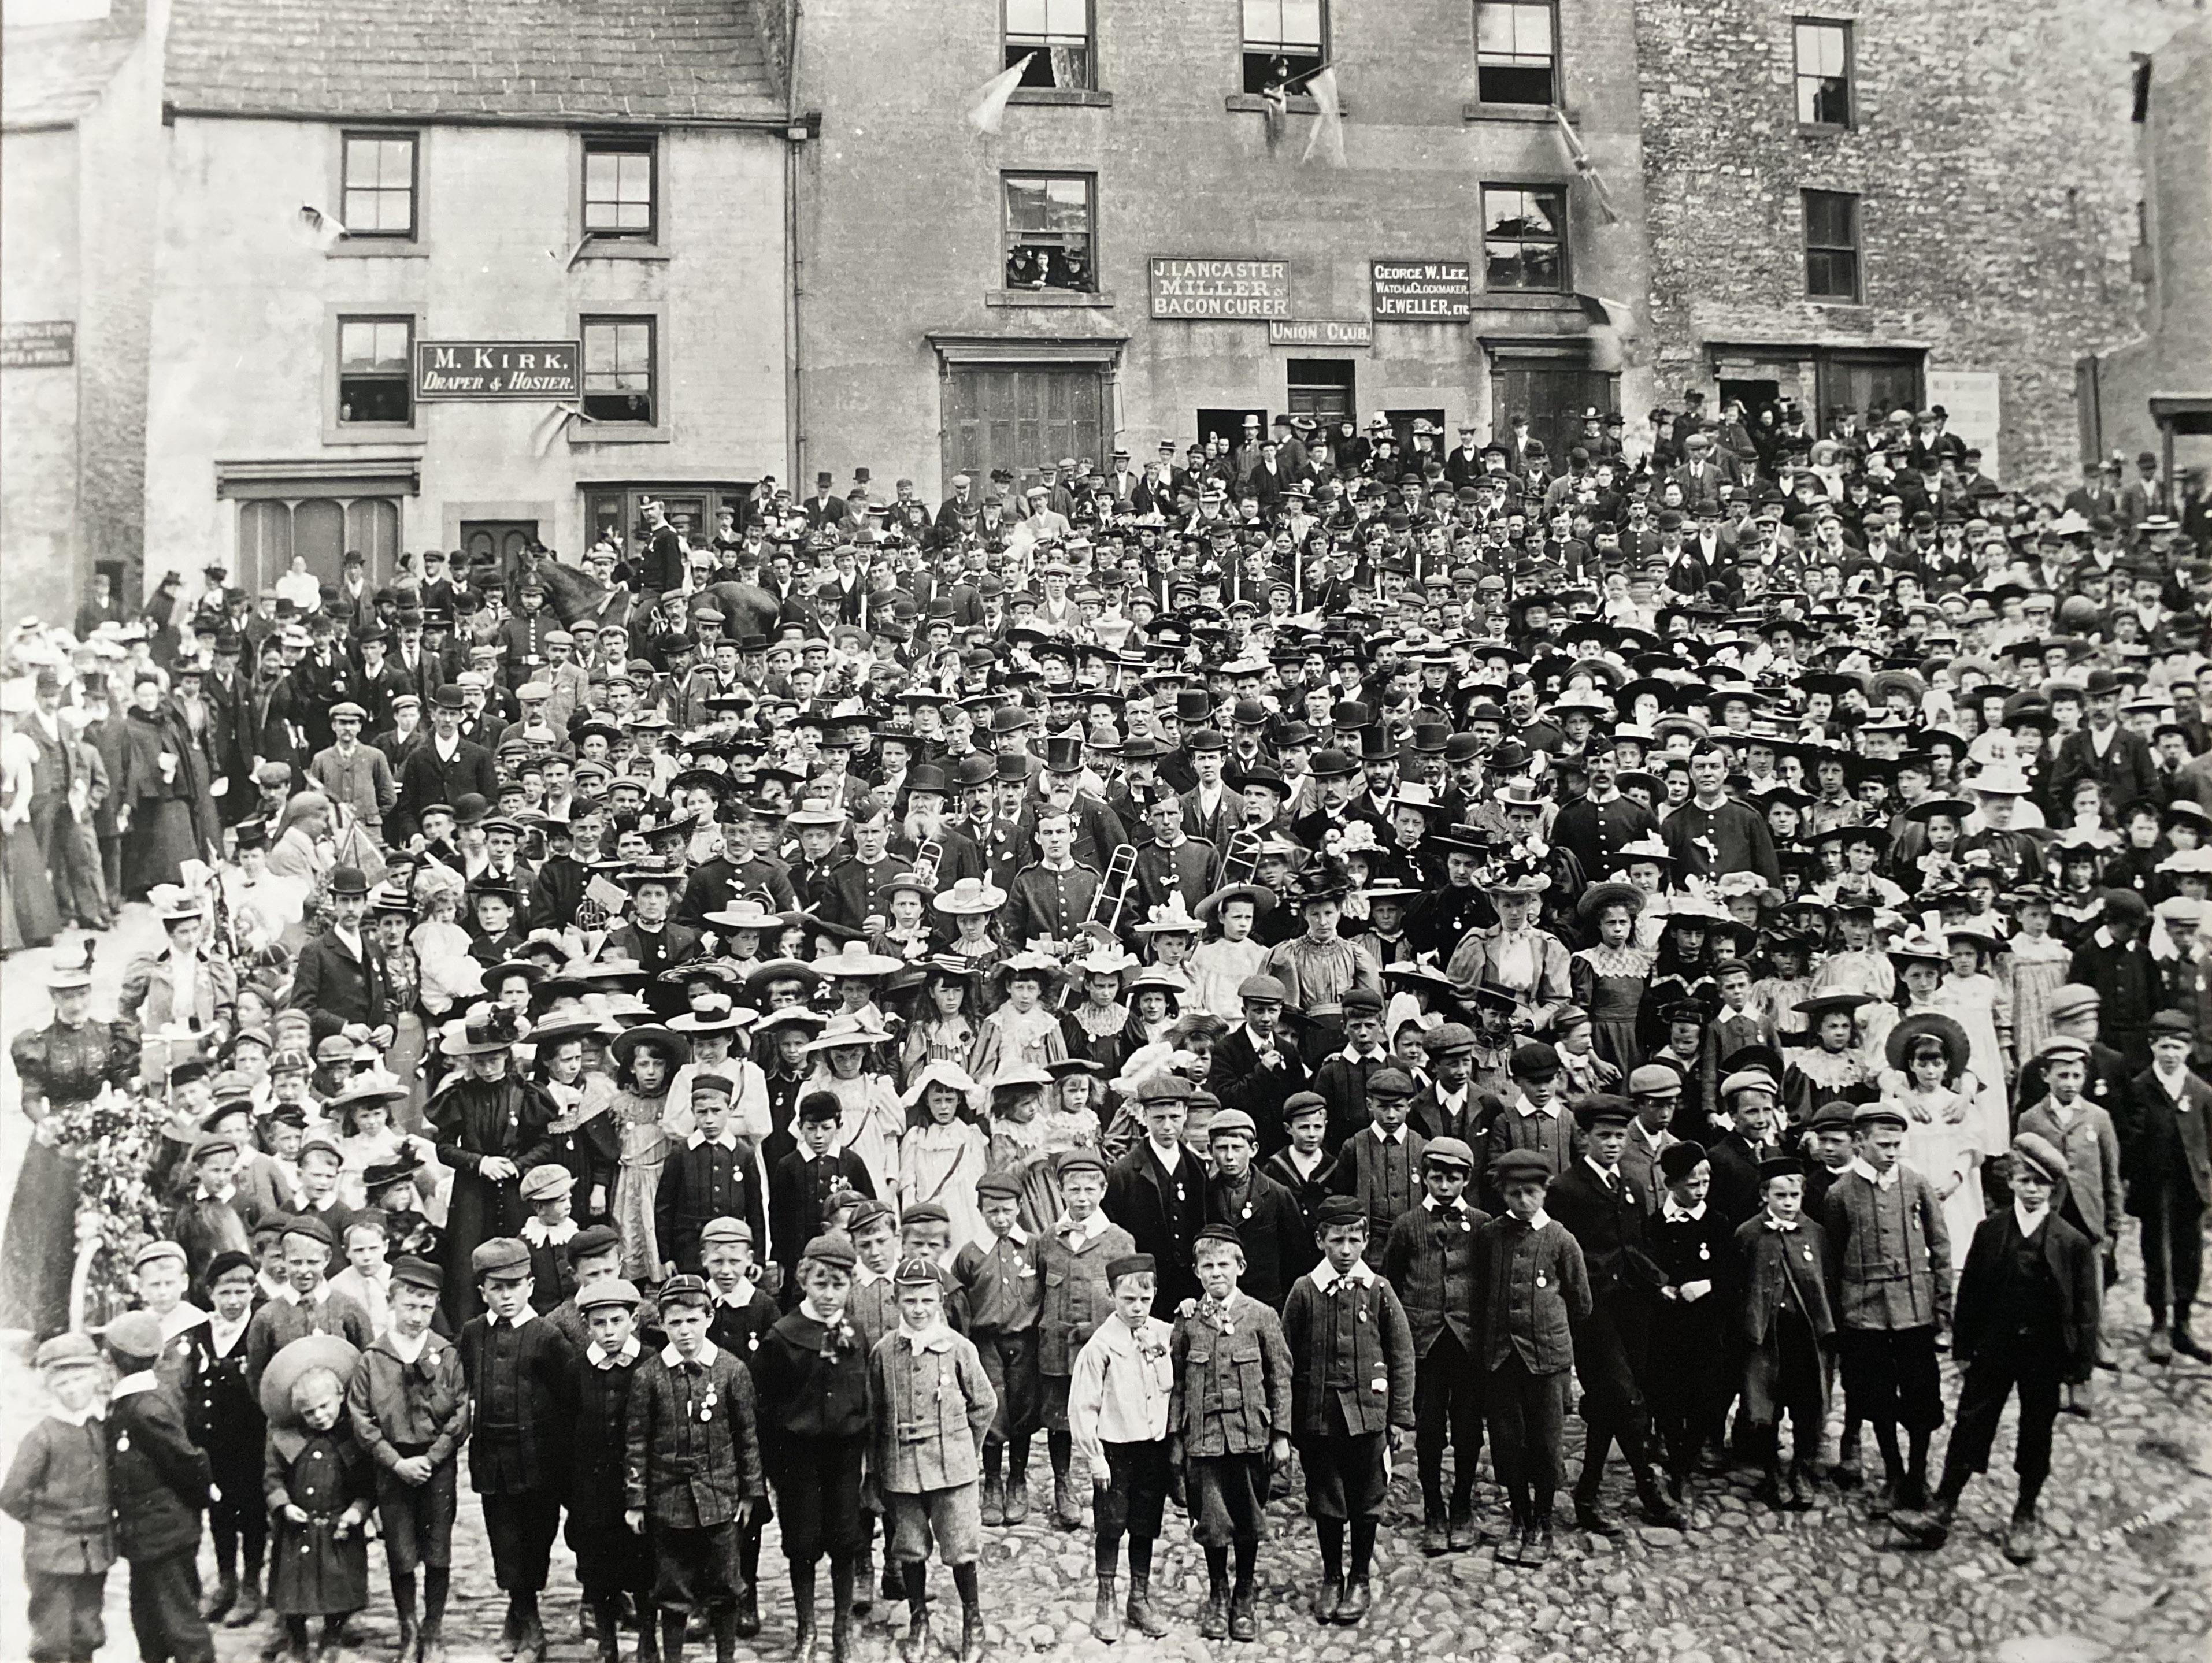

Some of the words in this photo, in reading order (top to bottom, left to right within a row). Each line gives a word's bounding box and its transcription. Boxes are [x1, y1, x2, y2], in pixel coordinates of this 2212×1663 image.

[1160, 280, 1270, 296] MILLER
[1155, 298, 1221, 314] BACON
[1224, 299, 1287, 314] CURER
[1272, 322, 1317, 339] UNION
[435, 348, 461, 369] M.
[490, 377, 502, 391] &
